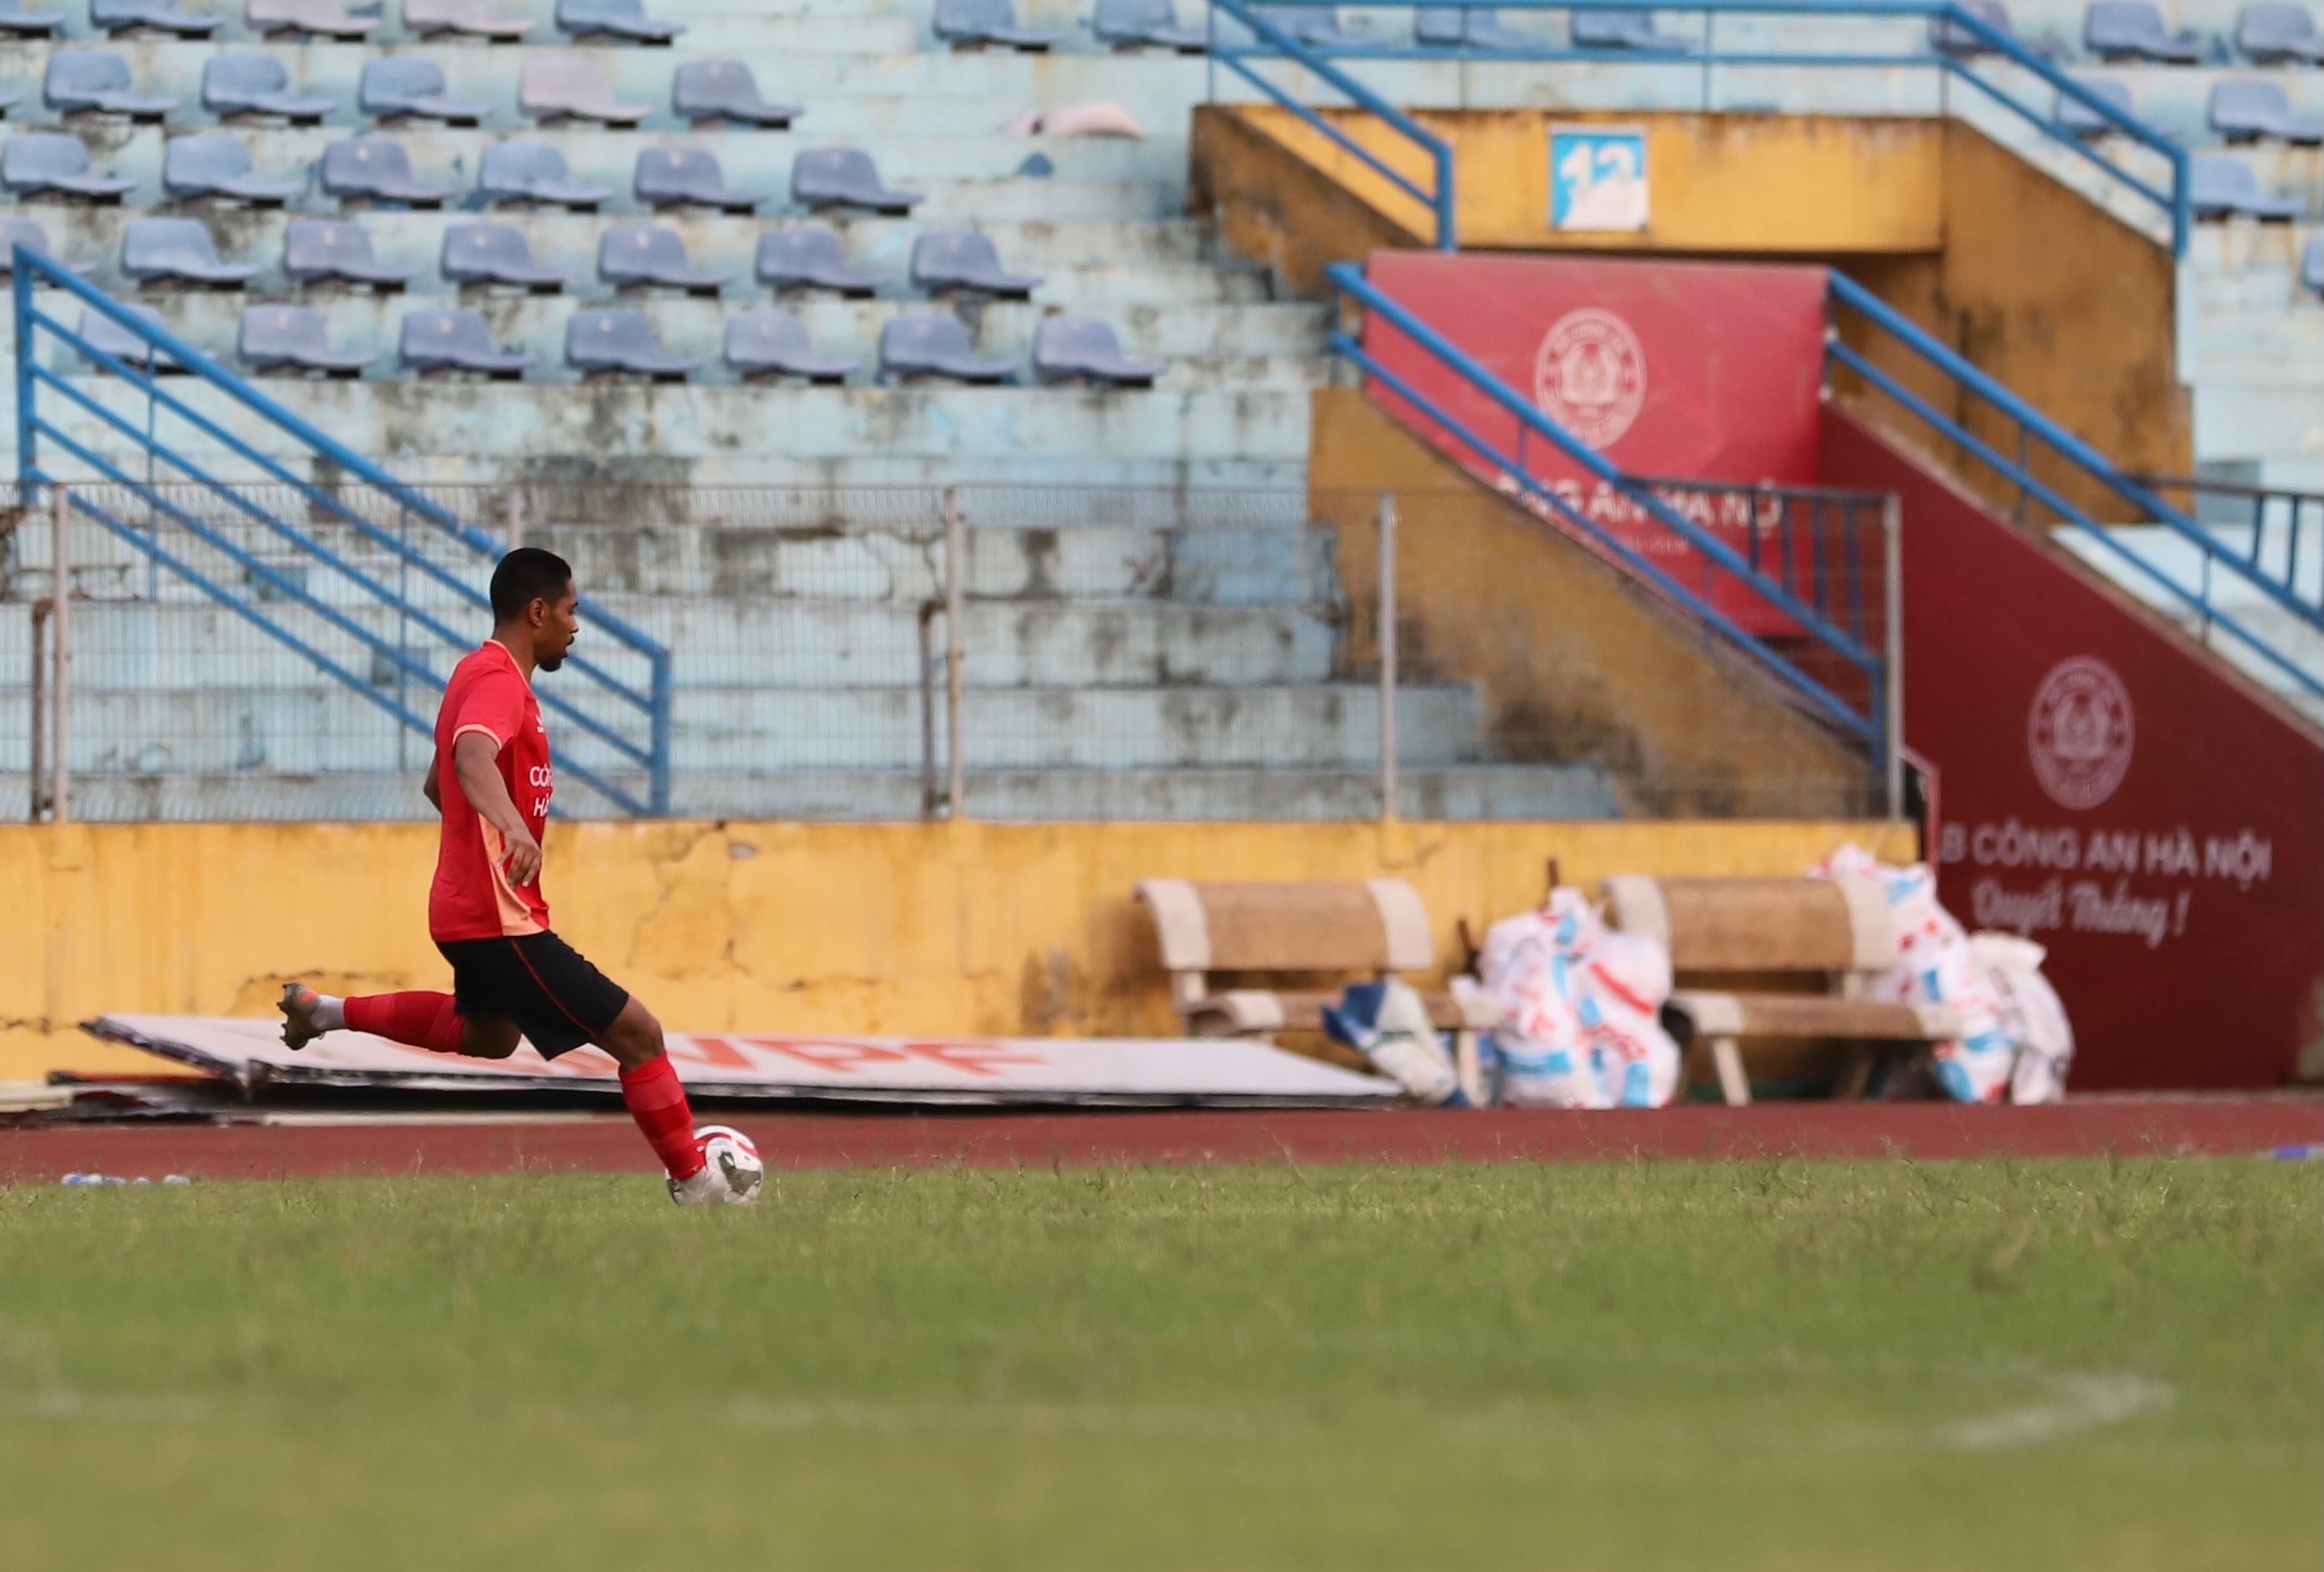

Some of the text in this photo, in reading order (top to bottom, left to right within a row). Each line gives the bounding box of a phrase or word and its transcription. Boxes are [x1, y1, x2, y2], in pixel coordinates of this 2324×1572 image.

[1974, 818, 2080, 867] CÔNG
[2085, 828, 2141, 873] AN
[2146, 826, 2199, 876] HÀ
[2206, 829, 2273, 890] NỘI
